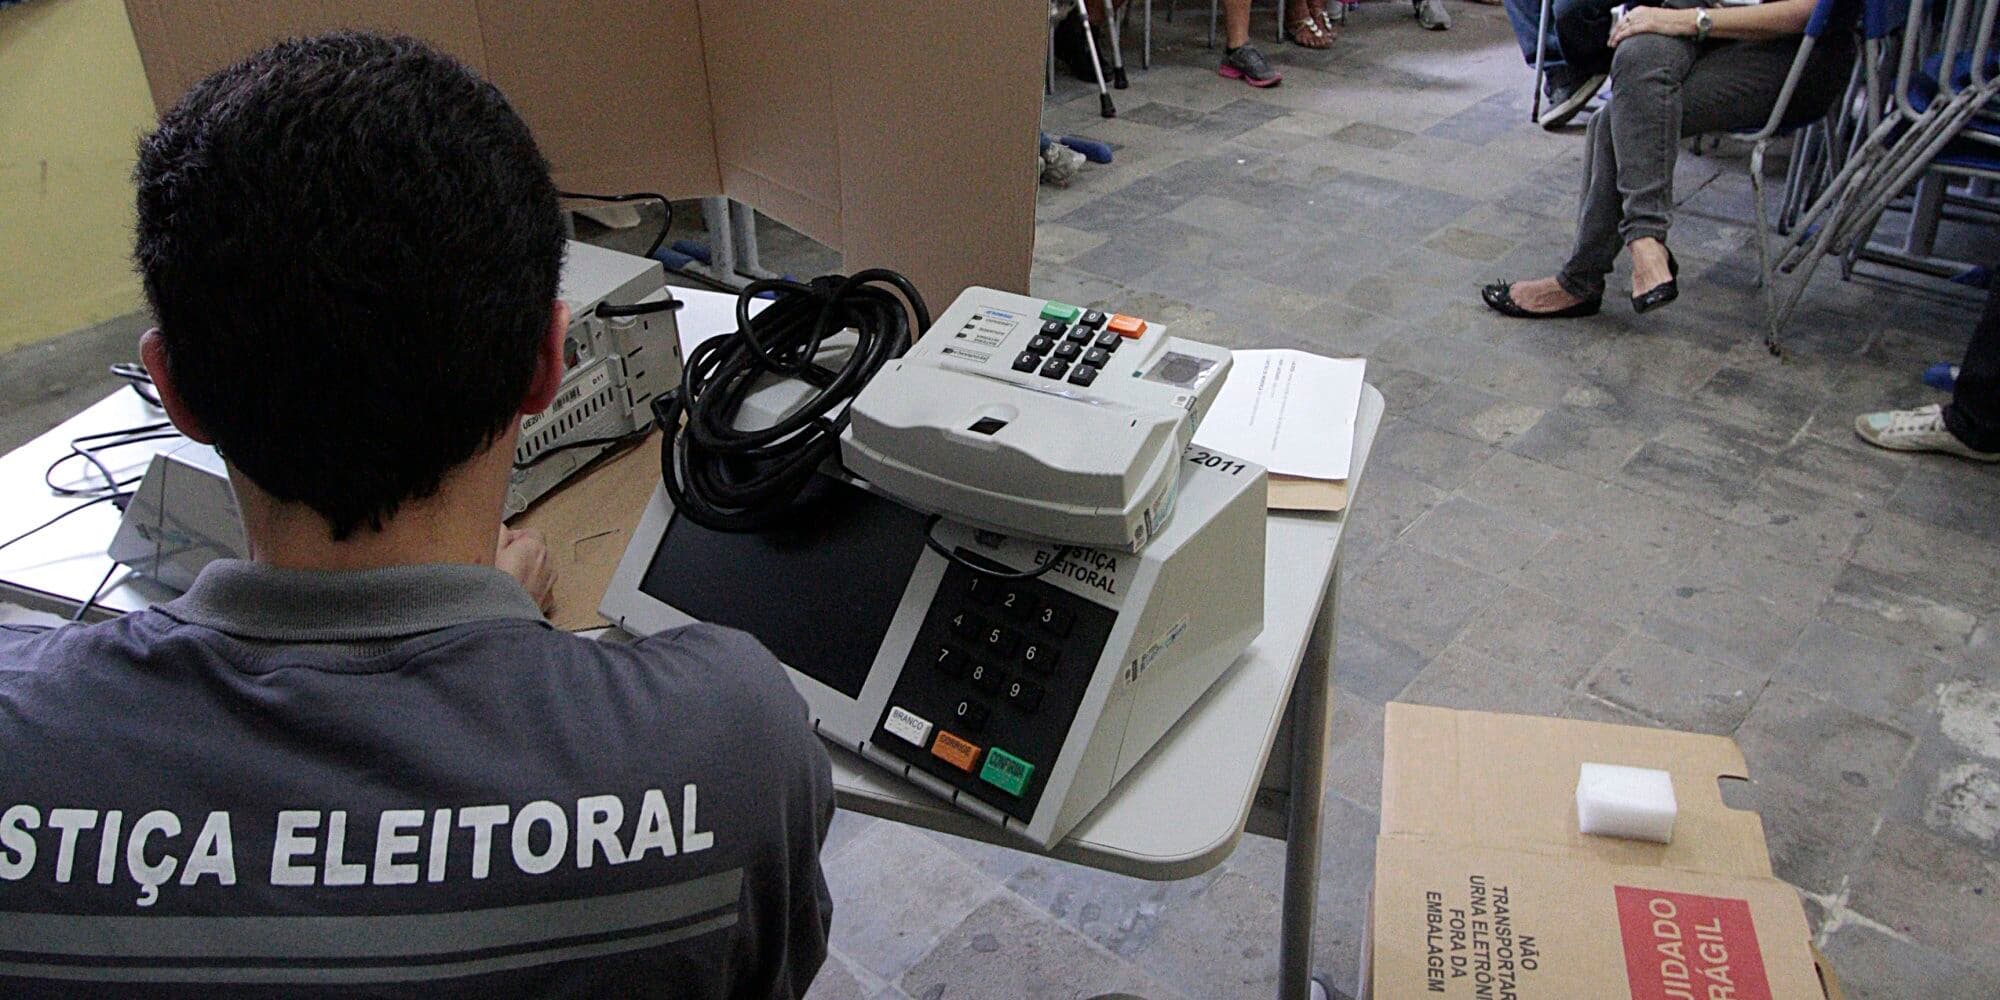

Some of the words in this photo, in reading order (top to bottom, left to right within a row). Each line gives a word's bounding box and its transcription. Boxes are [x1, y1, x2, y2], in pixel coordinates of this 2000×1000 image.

[1188, 450, 1246, 476] 2011
[1053, 543, 1116, 573] STIÇA
[1003, 592, 1016, 607] 2
[1042, 608, 1053, 622] 3
[953, 613, 964, 627] 4
[989, 629, 1000, 643] 5
[1026, 646, 1037, 660] 6
[938, 648, 949, 662] 7
[973, 666, 983, 680] 8
[1010, 683, 1020, 697] 9
[892, 710, 924, 731] BRANCO
[957, 702, 968, 716] 0
[0, 804, 237, 906] STIÇA
[270, 784, 714, 886] ELEITORAL
[1469, 875, 1487, 917] URNA
[1426, 891, 1445, 993] EMBALAGEM
[1449, 908, 1467, 952] FORA
[1492, 886, 1517, 1000] TRANSPORTAR
[1450, 955, 1468, 978] DA
[1518, 935, 1540, 971] NÃO
[1695, 917, 1736, 1000] RÁGIL
